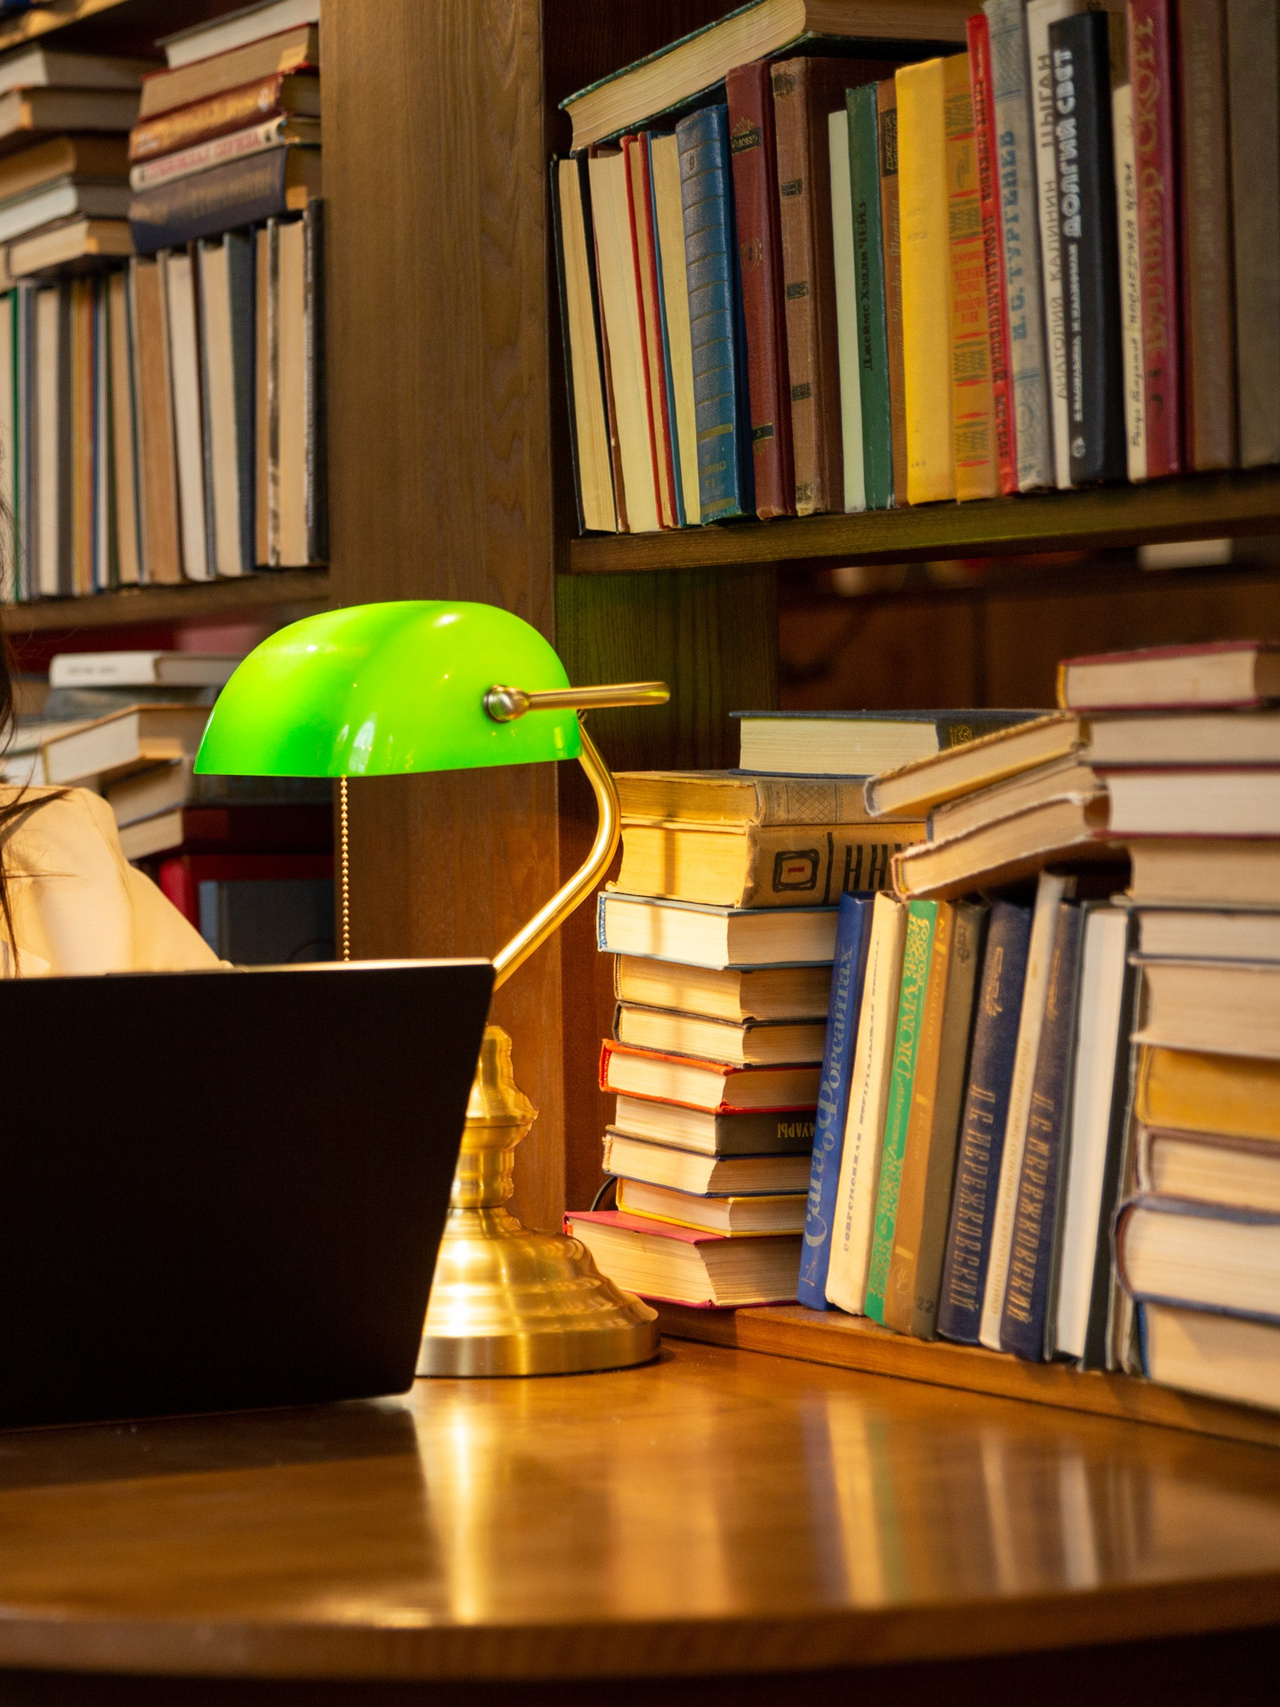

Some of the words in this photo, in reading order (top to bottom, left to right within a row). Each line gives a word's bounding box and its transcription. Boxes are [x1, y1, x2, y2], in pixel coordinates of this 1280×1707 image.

[1036, 54, 1055, 148] ЦЫГАН
[1053, 48, 1074, 114] СВЕТ
[1132, 16, 1160, 153] СКОТТ
[1000, 130, 1025, 282] ТУРГЕНЕВ
[1055, 118, 1081, 238] ДОЛГИЙ
[859, 252, 871, 301] Хэдли
[1043, 181, 1060, 281] КАЛИНИН
[860, 305, 874, 371] Джеймс
[1049, 297, 1068, 399] АНАТОЛИЙ
[817, 947, 854, 1129] Форсайтах
[822, 1133, 834, 1150] о
[804, 1149, 828, 1247] Сага
[948, 1129, 992, 1311] МЕРЕЖКОВСКИЙ
[1007, 1141, 1050, 1323] МЕРЕЖКОВСКИЙ
